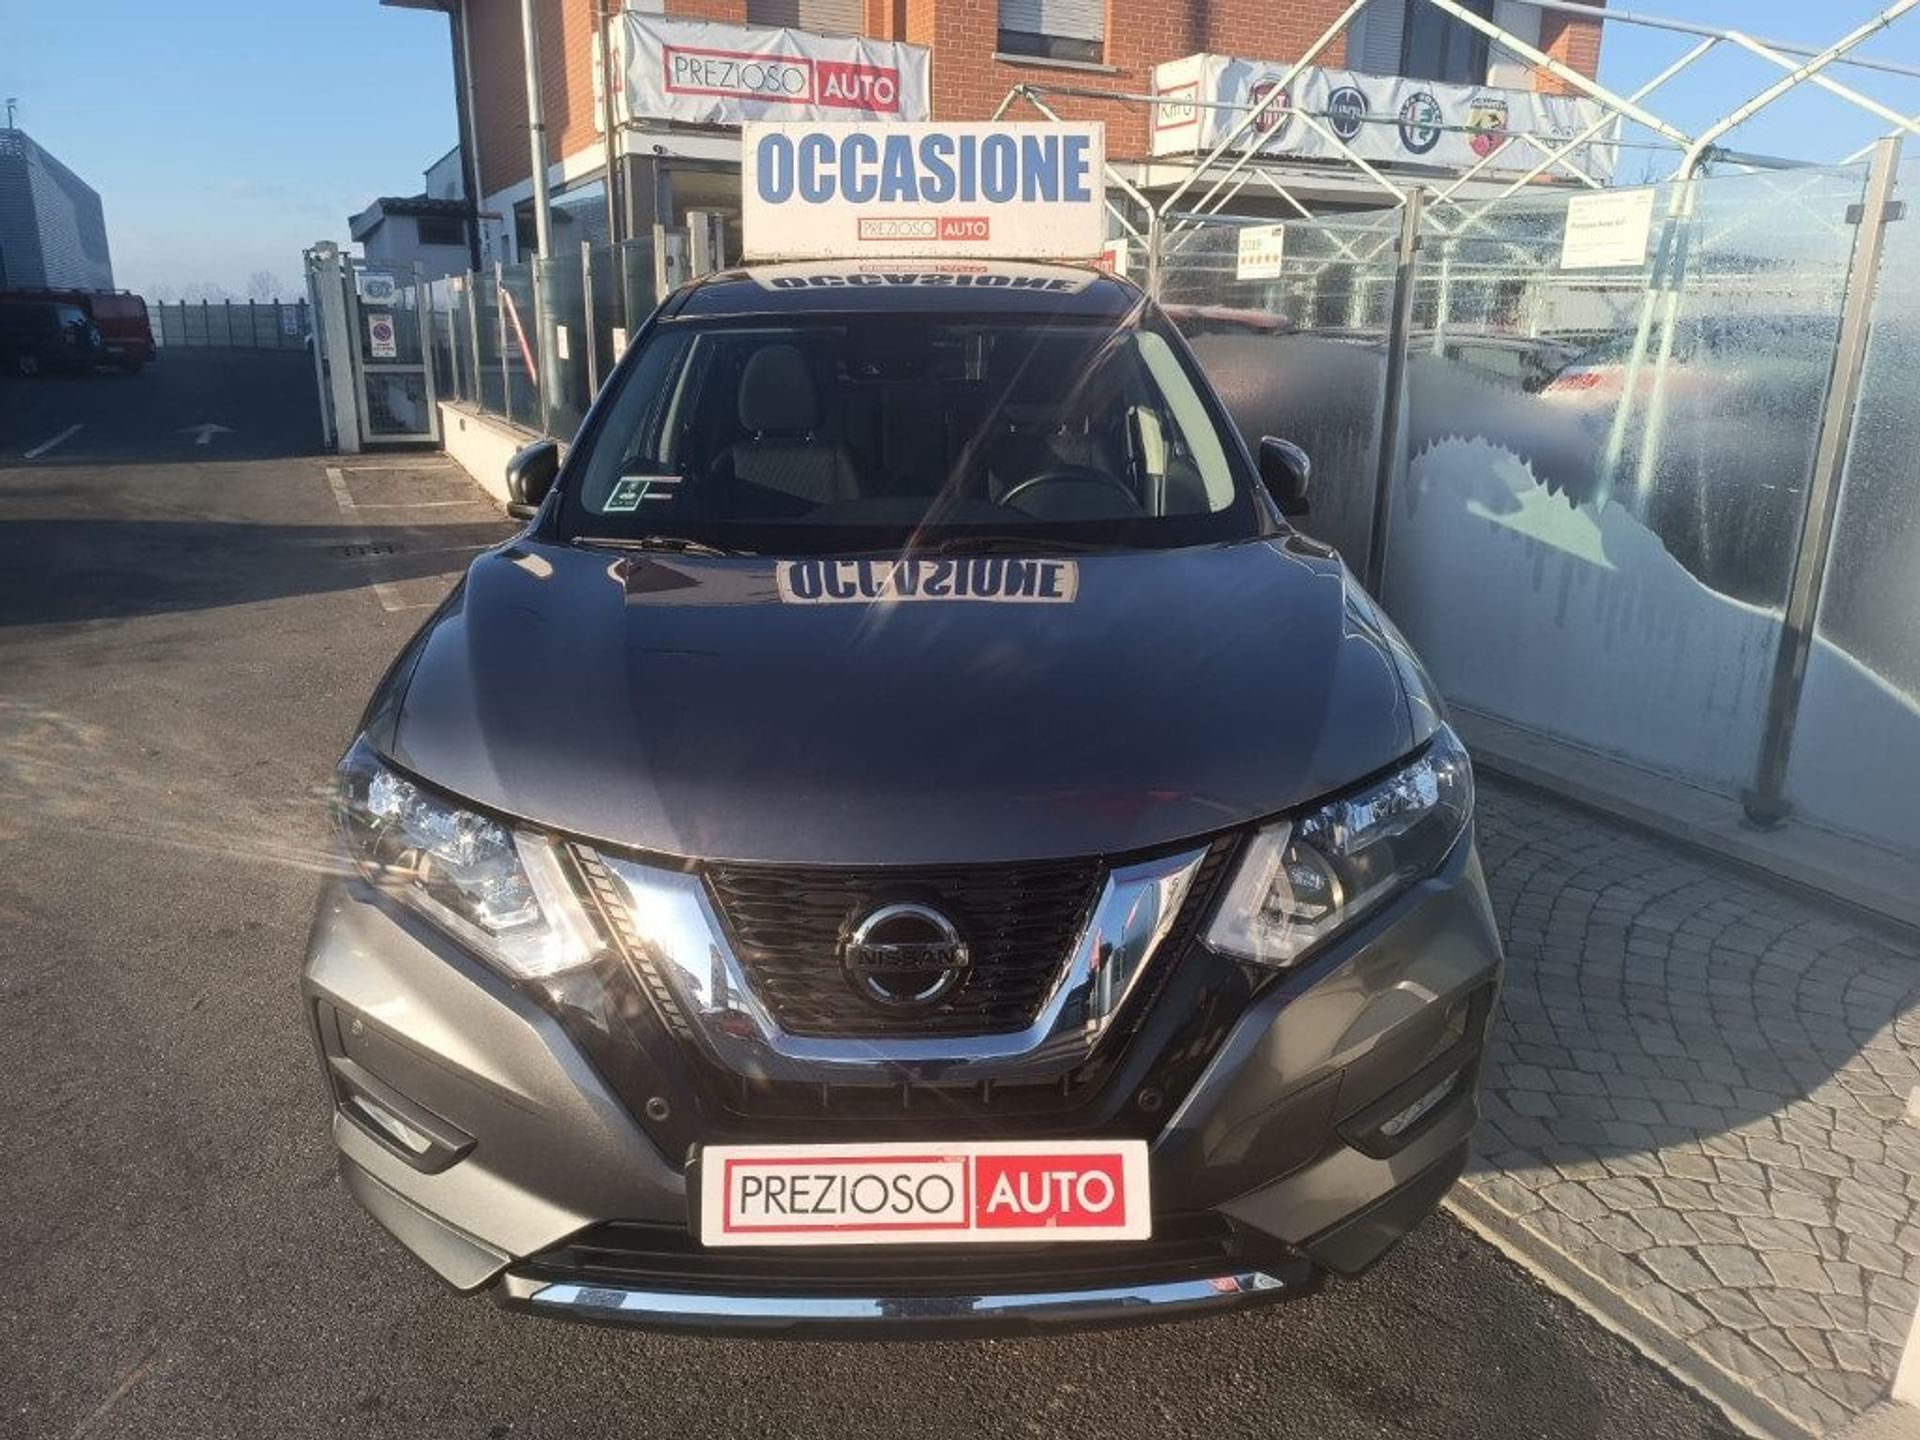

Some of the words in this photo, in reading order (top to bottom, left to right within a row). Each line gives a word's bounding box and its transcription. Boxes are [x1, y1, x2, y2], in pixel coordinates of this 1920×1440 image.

[674, 55, 806, 94] PREZIOSO
[823, 71, 894, 105] AUTO
[757, 133, 1091, 204] OCCASIONE
[863, 221, 935, 236] PREZIOSO
[943, 221, 987, 237] AUTO
[859, 947, 953, 966] NISSAN
[740, 1174, 954, 1214] PREZIOSO
[986, 1171, 1115, 1214] AUTO
